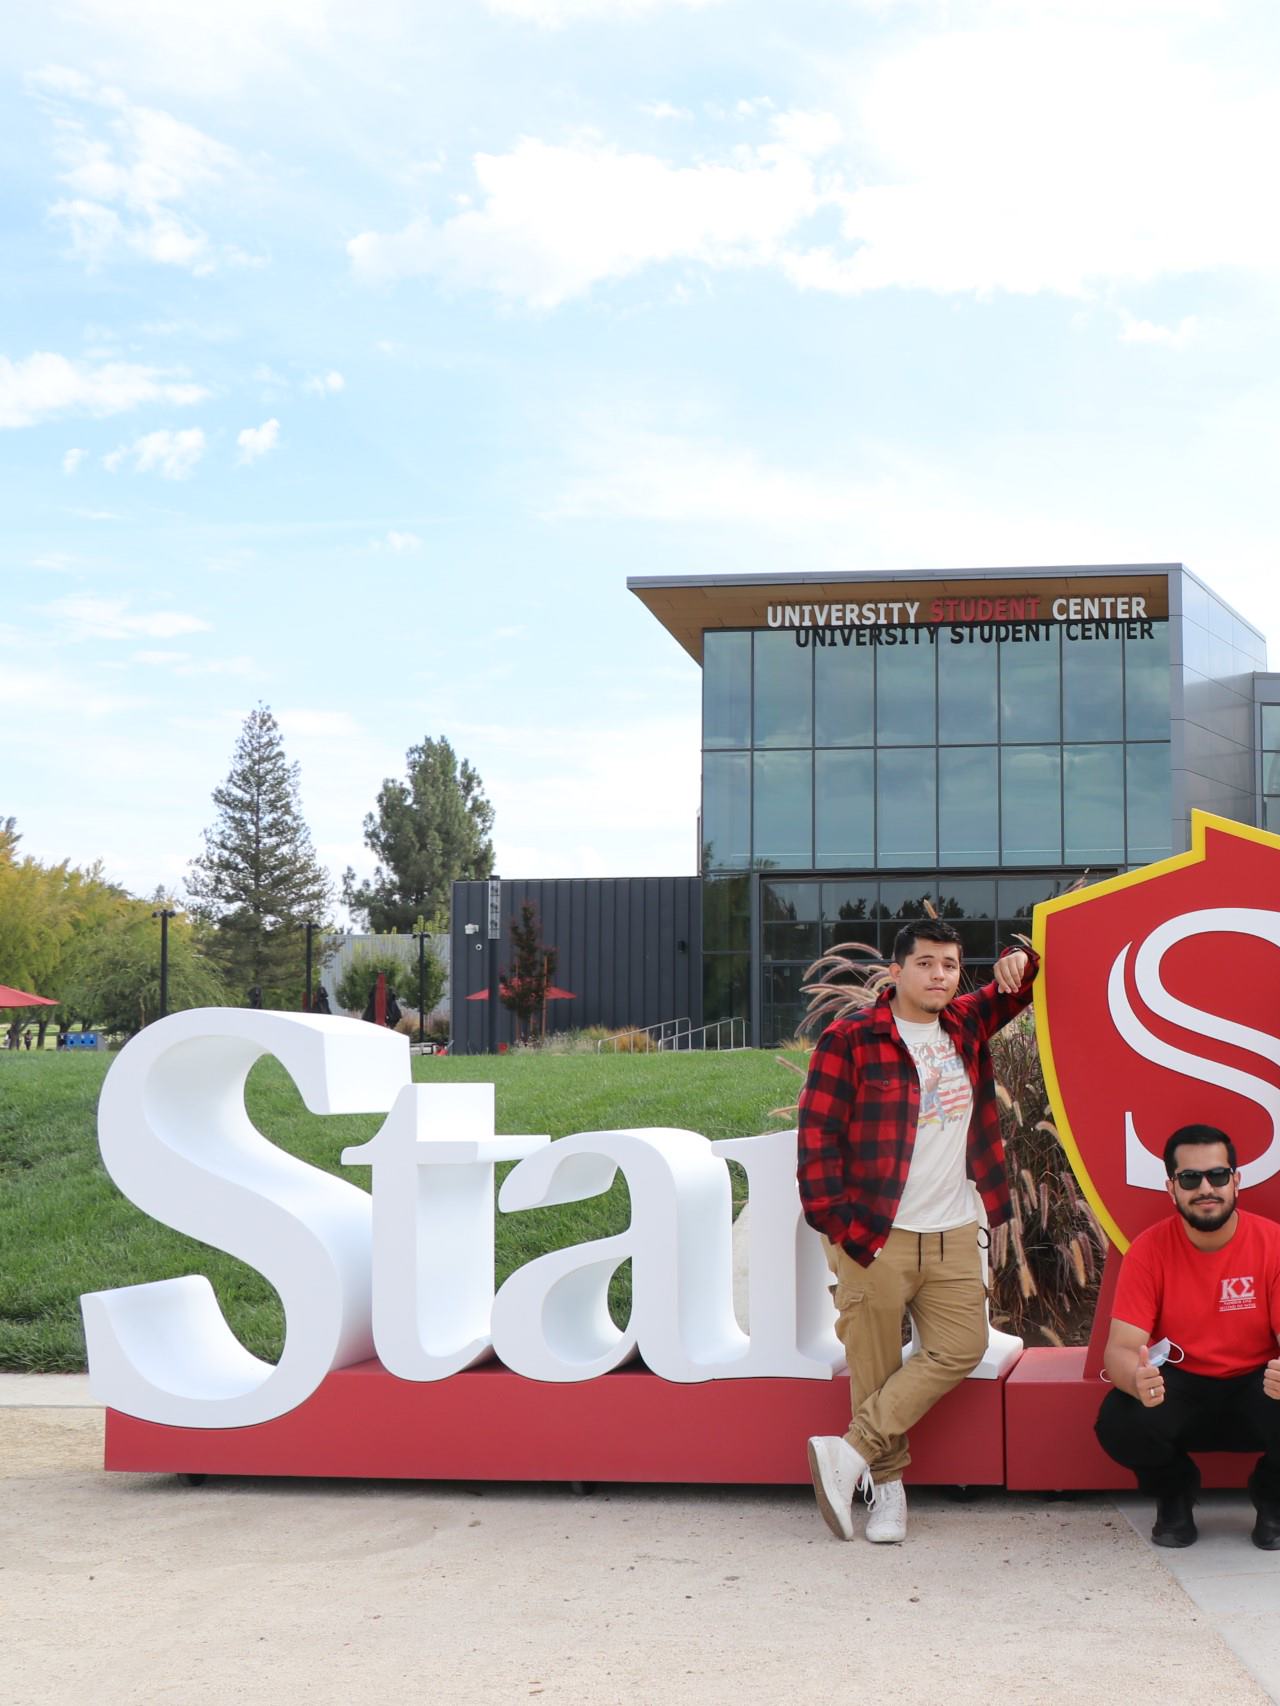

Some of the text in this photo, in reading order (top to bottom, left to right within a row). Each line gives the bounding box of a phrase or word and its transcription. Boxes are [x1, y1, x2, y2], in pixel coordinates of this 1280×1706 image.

[767, 596, 1147, 627] UNIVERSITY STUDENT CENTER
